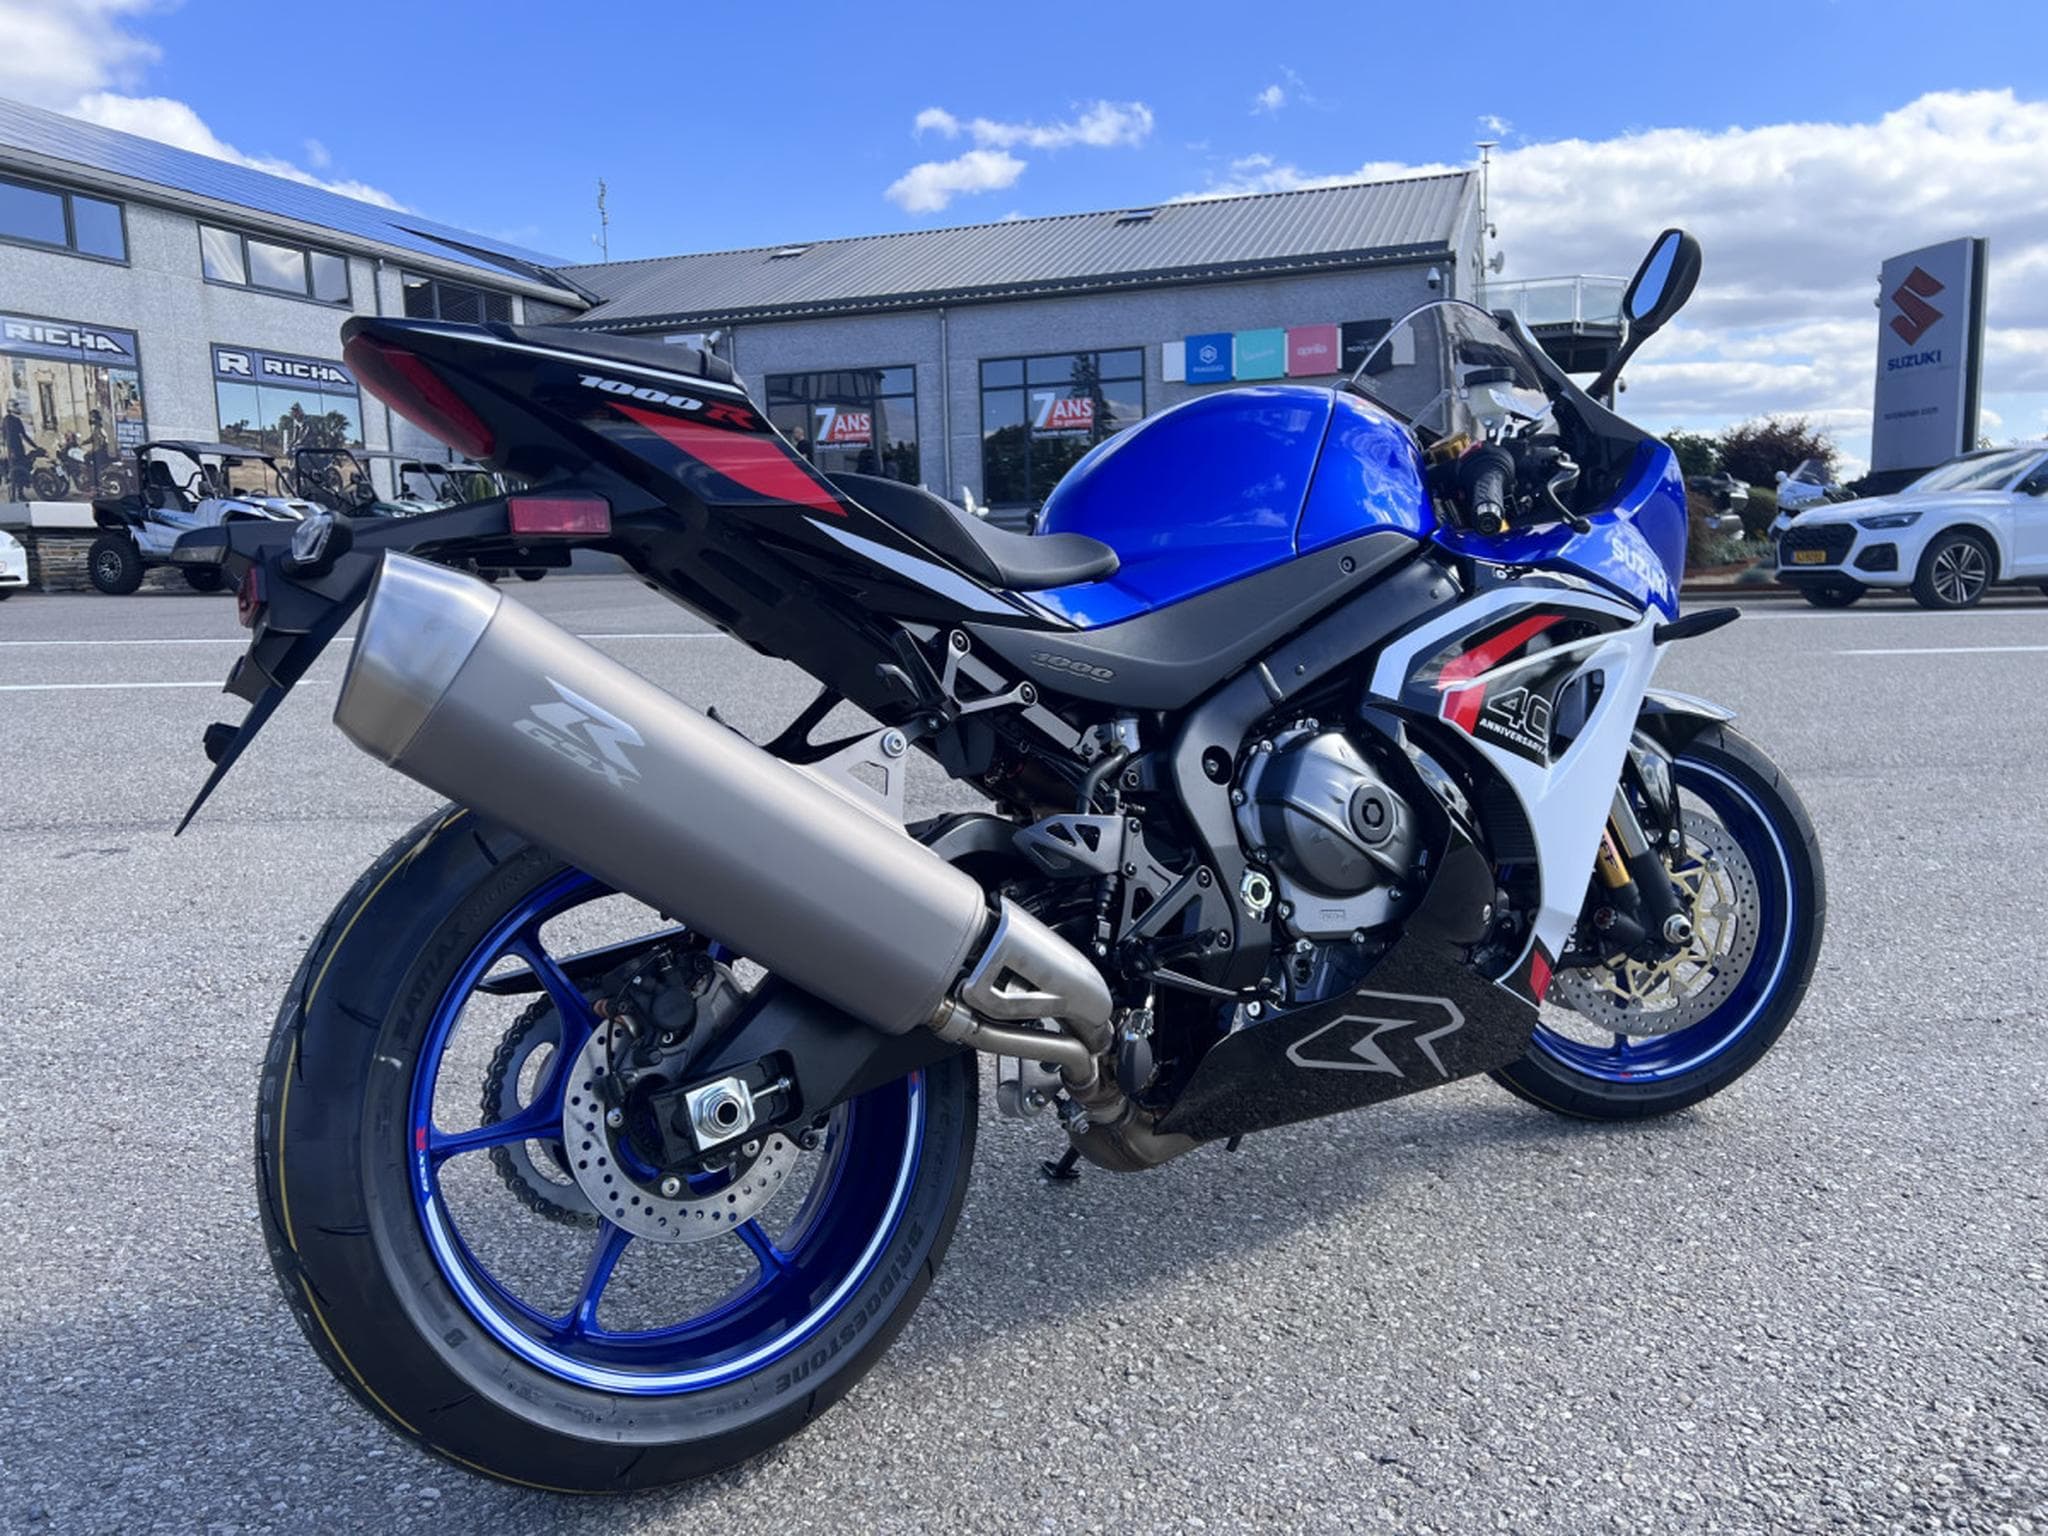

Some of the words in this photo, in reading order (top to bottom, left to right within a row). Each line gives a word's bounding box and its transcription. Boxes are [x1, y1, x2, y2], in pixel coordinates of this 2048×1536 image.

[4, 322, 126, 354] RICHA
[217, 351, 251, 375] R
[263, 358, 352, 386] RICHA
[1887, 350, 1942, 371] SUZUKI
[815, 407, 836, 441] 7
[834, 413, 870, 432] ANS
[1032, 392, 1056, 427] 7
[1053, 398, 1093, 418] ANS
[1611, 537, 1669, 604] SUZUKI
[1031, 652, 1115, 679] 1000
[1486, 686, 1553, 743] 40
[775, 1222, 924, 1395] BRIDGESTONE
